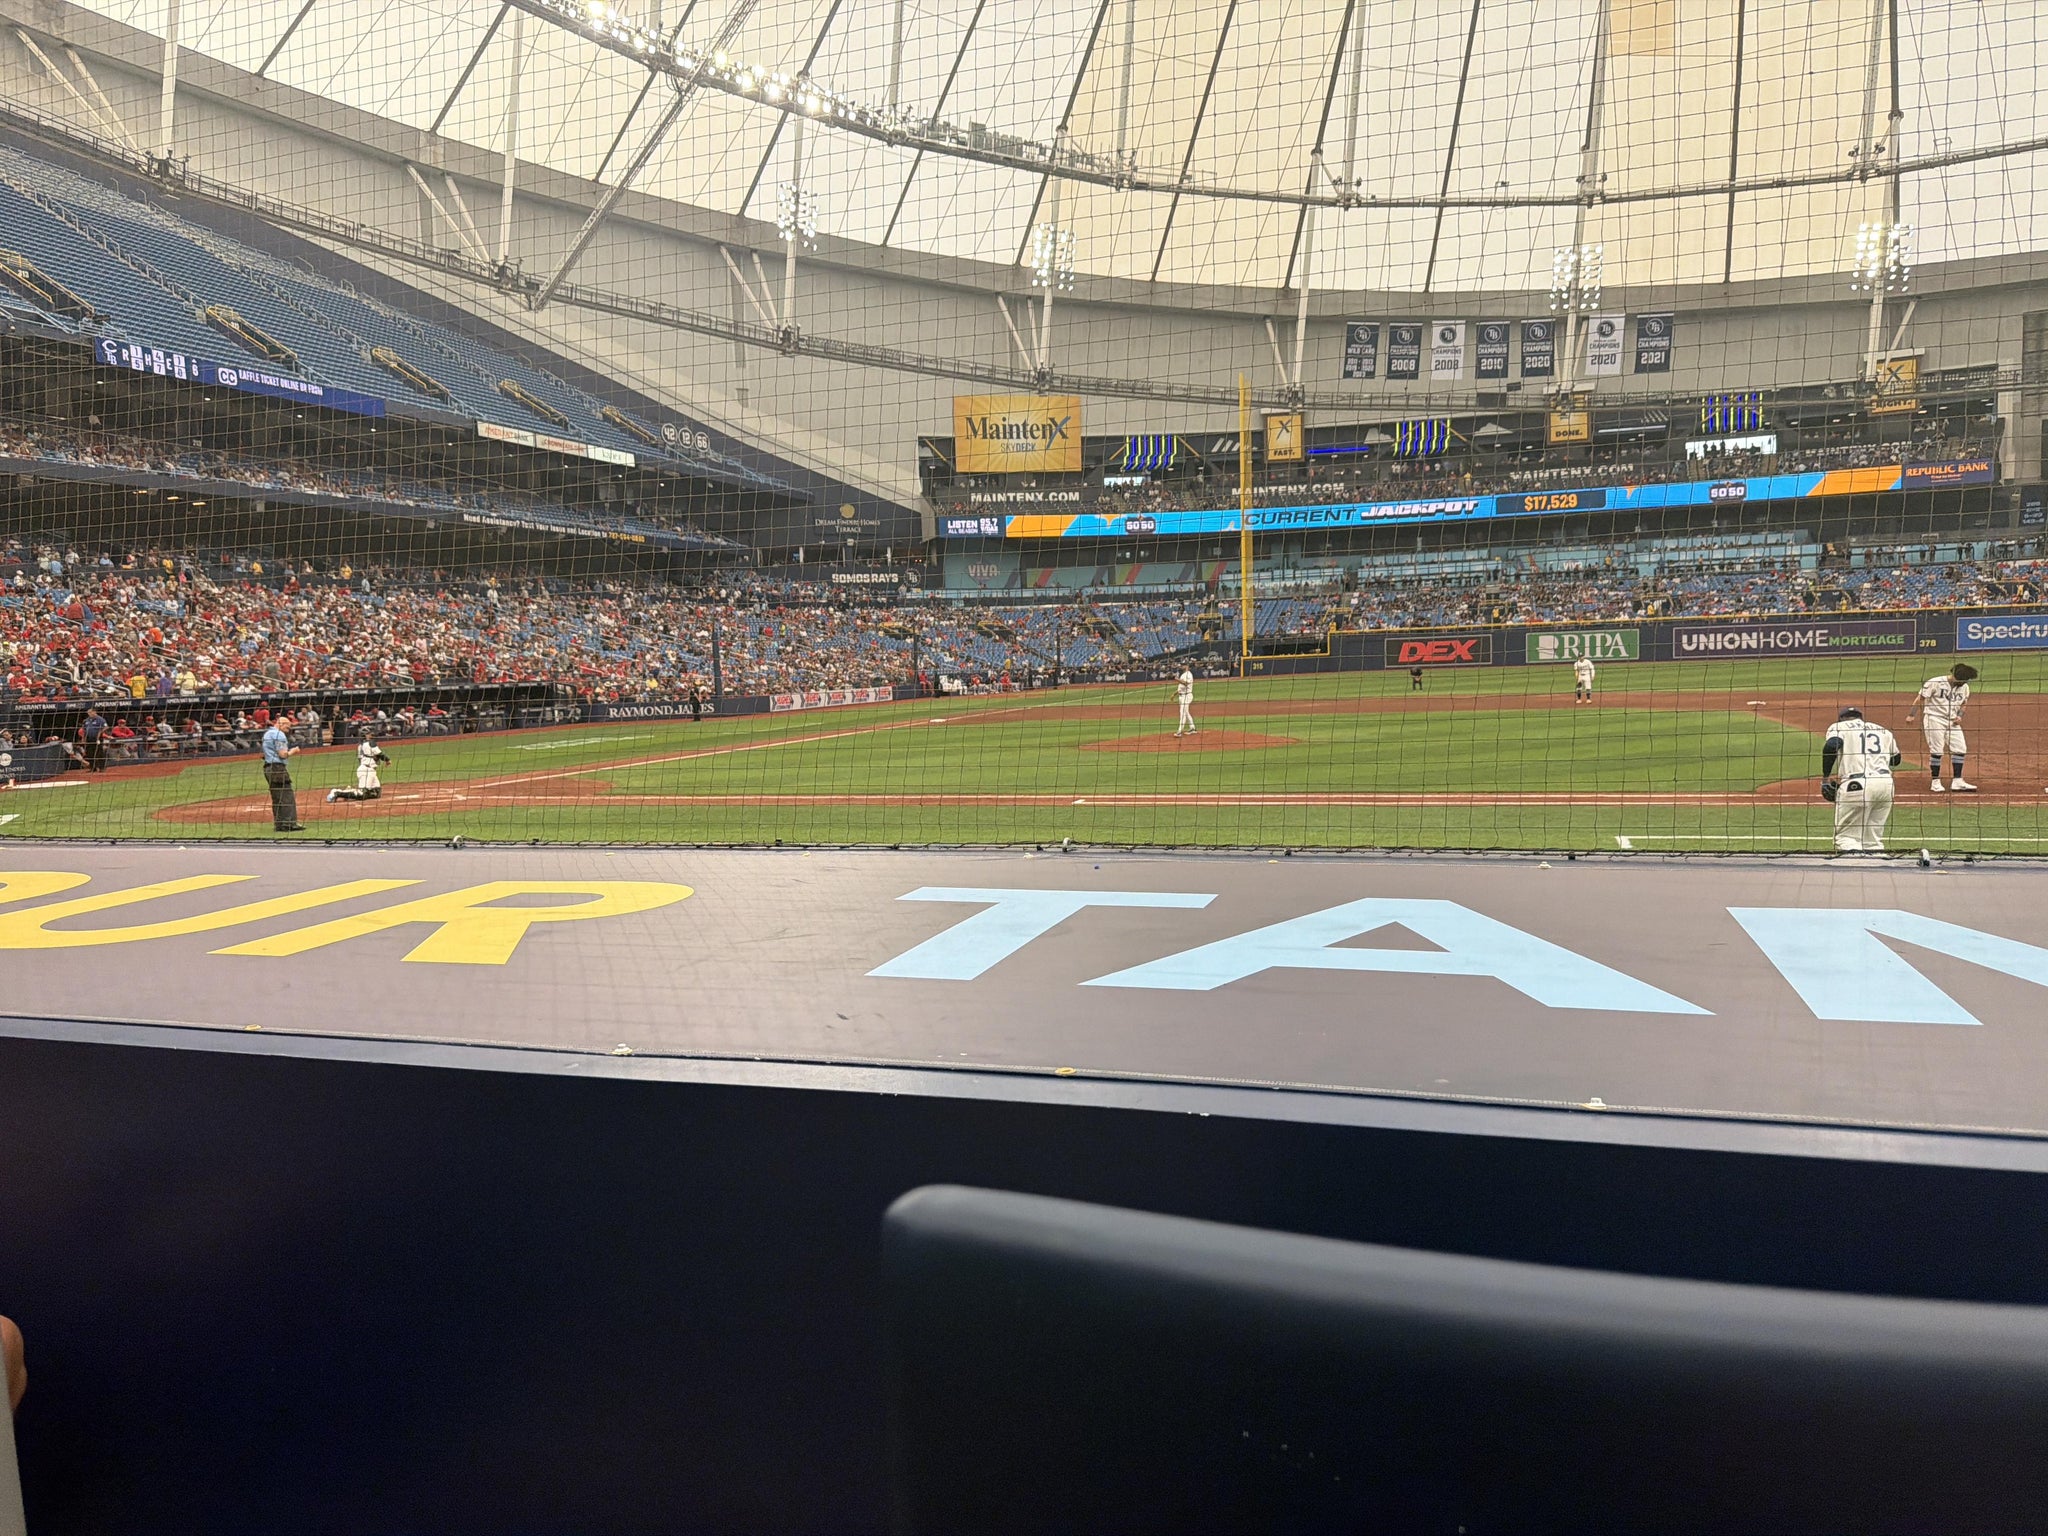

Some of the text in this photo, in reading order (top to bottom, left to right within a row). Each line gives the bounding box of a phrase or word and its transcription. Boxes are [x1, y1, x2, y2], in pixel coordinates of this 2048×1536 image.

[1638, 340, 1670, 348] CHAMPIONS
[122, 348, 129, 361] R
[145, 353, 152, 366] H
[166, 358, 172, 370] E
[1481, 358, 1504, 370] 2010
[1526, 356, 1550, 368] 2020
[1591, 354, 1617, 366] 2020
[1641, 352, 1665, 364] 2021
[1392, 359, 1416, 371] 2008
[1434, 360, 1459, 371] 2008
[260, 374, 280, 387] TICKET
[280, 378, 299, 391] ONLINE
[664, 427, 675, 440] 42
[682, 431, 691, 444] 12
[965, 415, 1072, 450] MaintenX
[697, 435, 708, 448] 66
[1000, 442, 1037, 453] SKYDECK
[1906, 464, 1956, 477] REPUBLIC
[1958, 462, 1989, 473] BANK
[970, 491, 1080, 503] MAINTENX.COM
[1524, 494, 1578, 511] $17,529
[463, 514, 481, 523] Need
[1244, 501, 1479, 526] CURRENT JACKPOT
[835, 525, 861, 533] TERRACE
[947, 520, 978, 528] LISTEN
[968, 564, 998, 577] VIVA
[832, 573, 869, 583] SOMOS
[871, 573, 899, 582] RAYS
[1561, 632, 1629, 659] RIPA
[1829, 634, 1905, 647] MORTGAGE
[1920, 639, 1937, 647] 378
[1398, 639, 1477, 663] DEX
[609, 706, 673, 718] RAYMOND
[1859, 732, 1881, 755] 13
